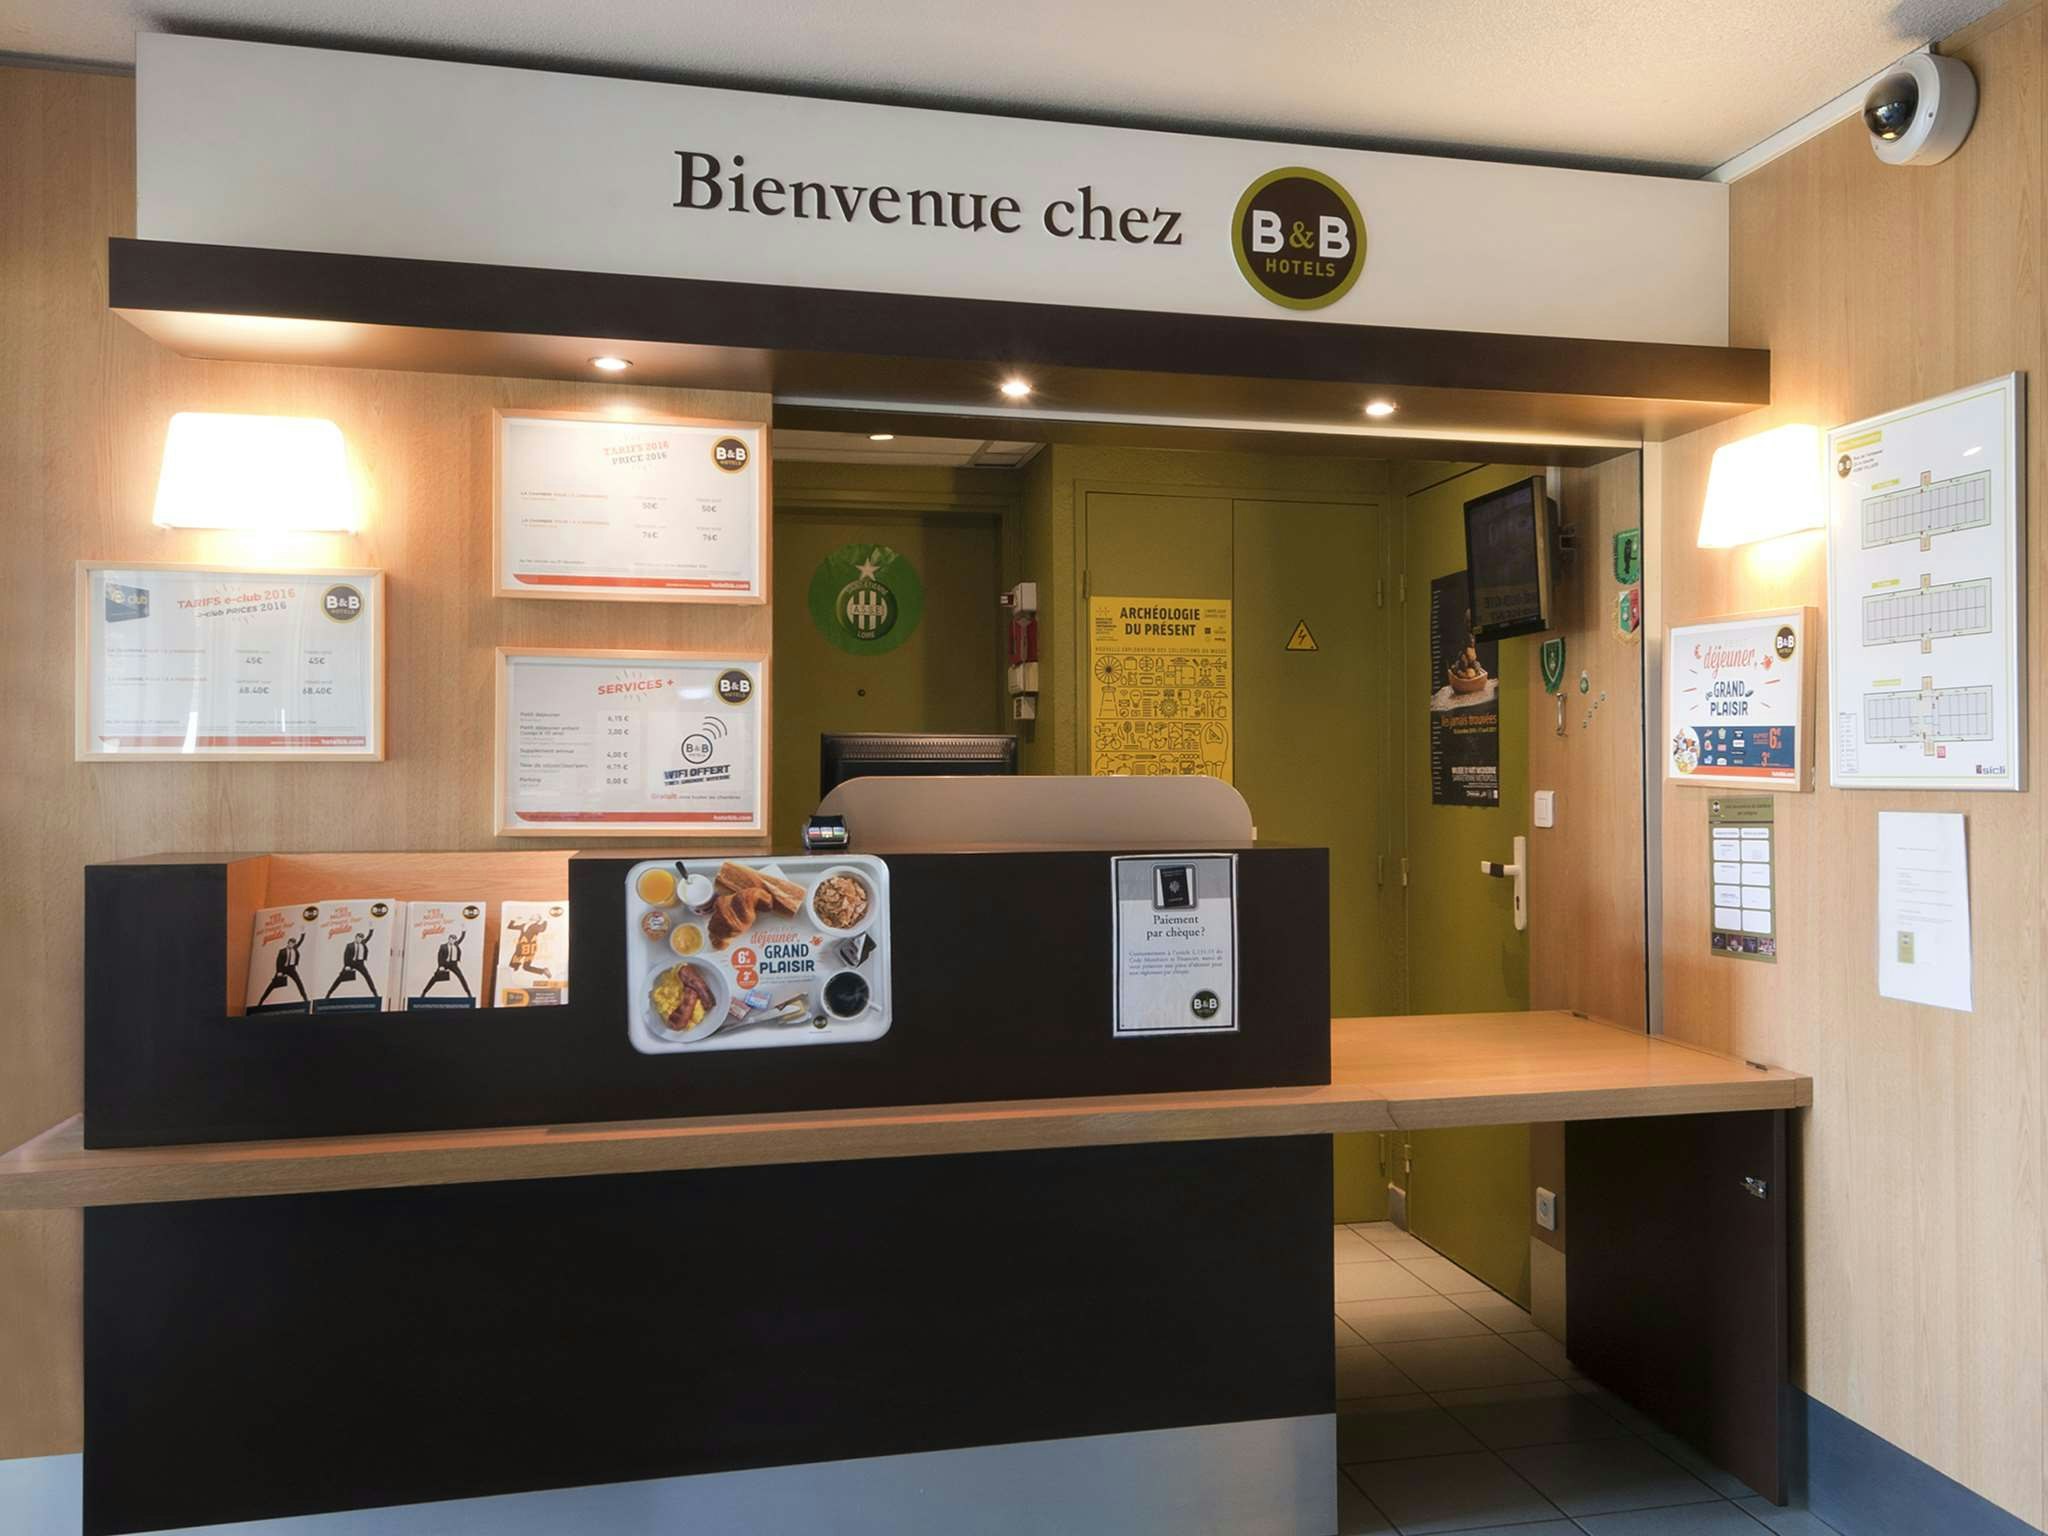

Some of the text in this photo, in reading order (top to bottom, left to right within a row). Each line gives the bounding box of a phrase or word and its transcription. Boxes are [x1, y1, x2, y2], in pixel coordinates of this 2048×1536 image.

[673, 151, 1182, 246] Bienvenue chez
[1252, 210, 1350, 259] B&B
[1266, 258, 1335, 277] HOTELS
[715, 447, 746, 461] B&B
[264, 587, 296, 601] 2016
[260, 601, 287, 613] 2016
[325, 595, 361, 609] B&B
[1120, 604, 1201, 620] ARCHÉOLOGIE
[1125, 623, 1141, 635] DU
[1144, 621, 1196, 636] PRÉSENT
[597, 679, 663, 696] SERVICES
[719, 678, 751, 692] B&B
[1713, 680, 1745, 697] GRAND
[1710, 701, 1749, 716] PLAISIR
[689, 765, 731, 777] OFFERT
[1153, 915, 1199, 925] Paiement
[1146, 930, 1163, 941] par
[764, 943, 809, 959] GRAND
[759, 960, 815, 975] PLAISIR
[1193, 998, 1218, 1010] B&B
